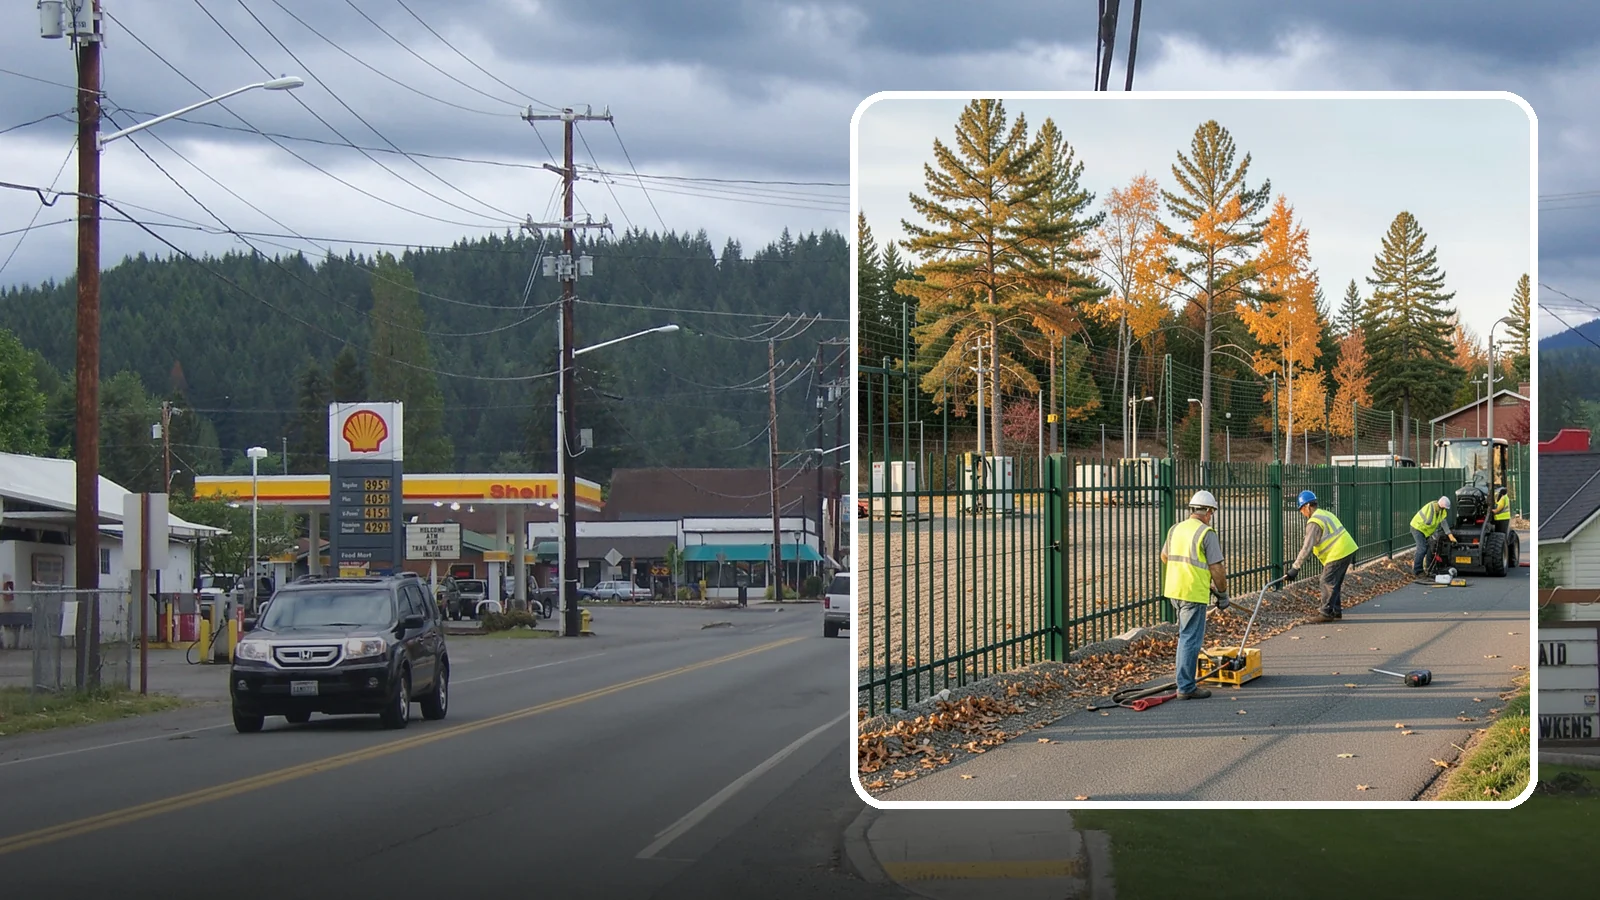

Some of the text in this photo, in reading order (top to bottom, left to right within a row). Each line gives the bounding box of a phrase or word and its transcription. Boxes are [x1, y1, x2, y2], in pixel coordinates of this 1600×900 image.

[366, 480, 383, 490] 395
[490, 484, 547, 499] Shell
[366, 494, 383, 504] 405
[366, 508, 383, 518] 415
[366, 522, 383, 532] 429
